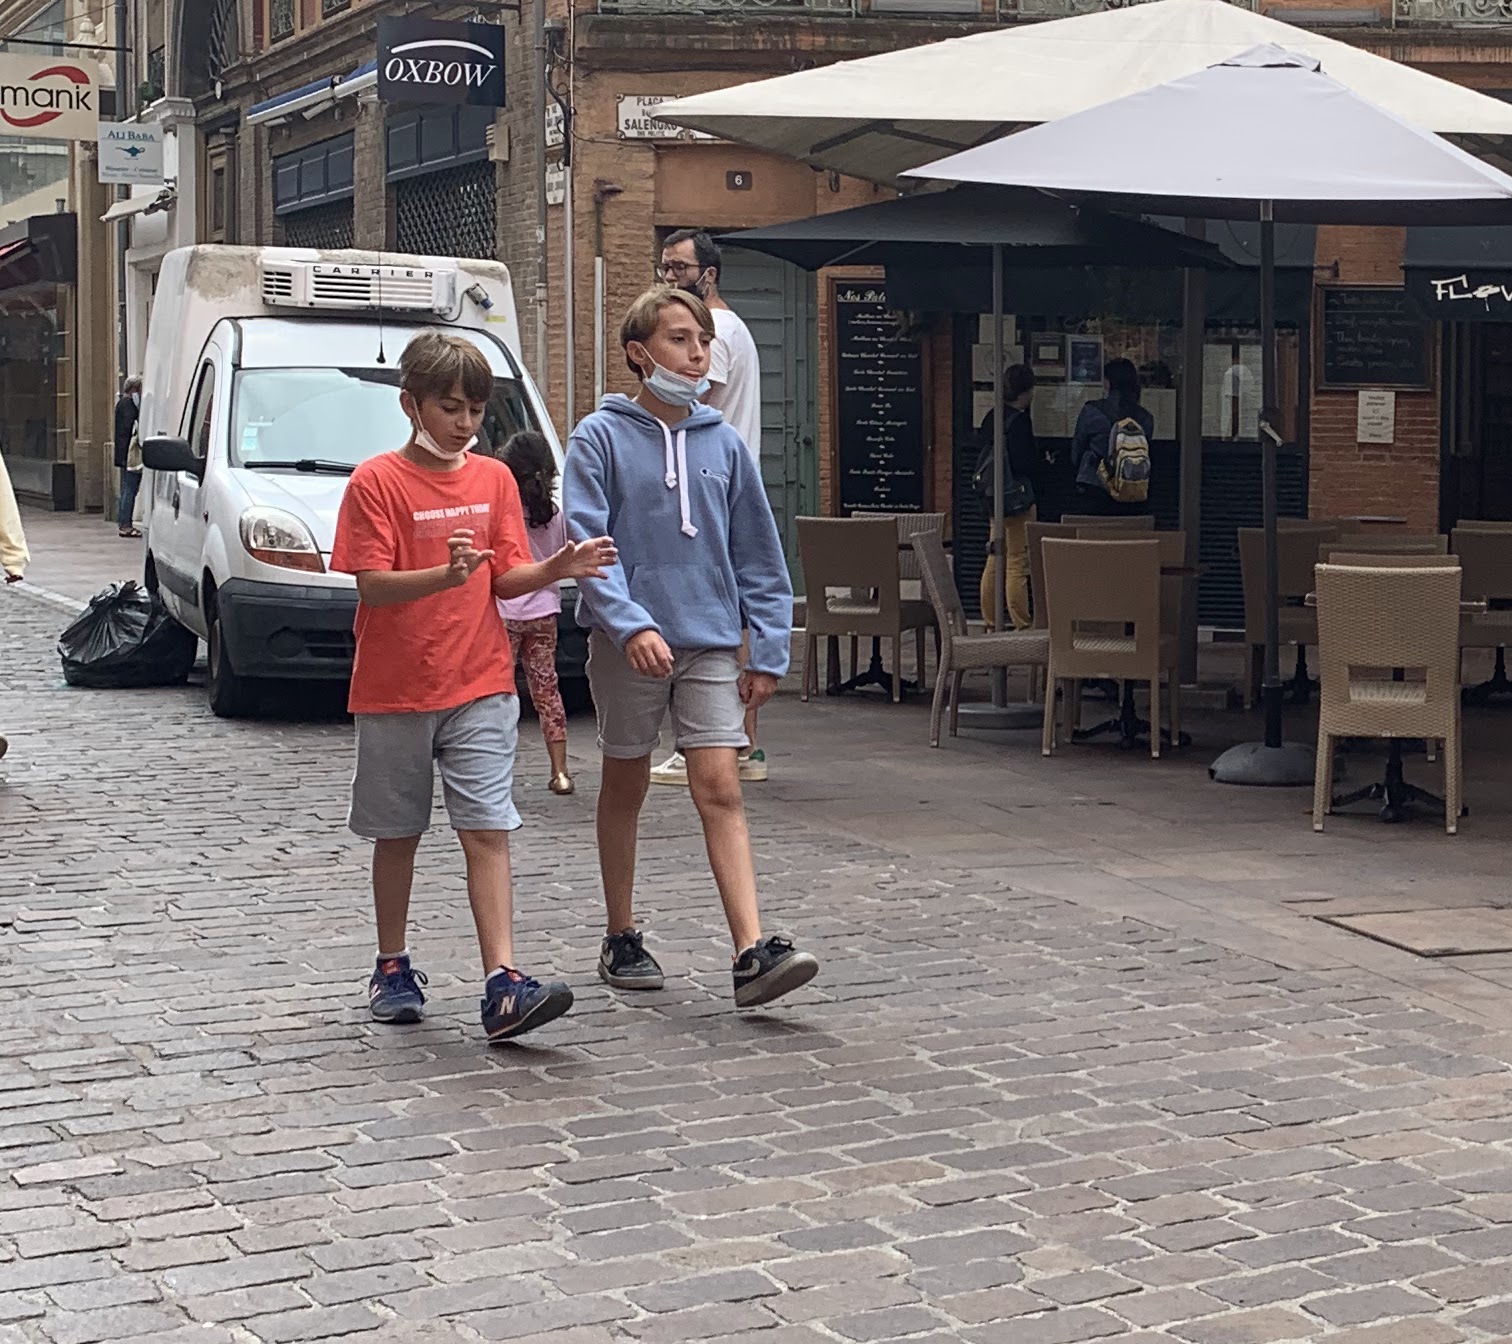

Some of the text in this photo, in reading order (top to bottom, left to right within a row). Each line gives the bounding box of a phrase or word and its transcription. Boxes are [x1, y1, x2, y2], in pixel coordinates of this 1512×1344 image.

[385, 58, 497, 87] OXBOW
[734, 175, 743, 186] 6
[313, 265, 433, 279] CARRIER
